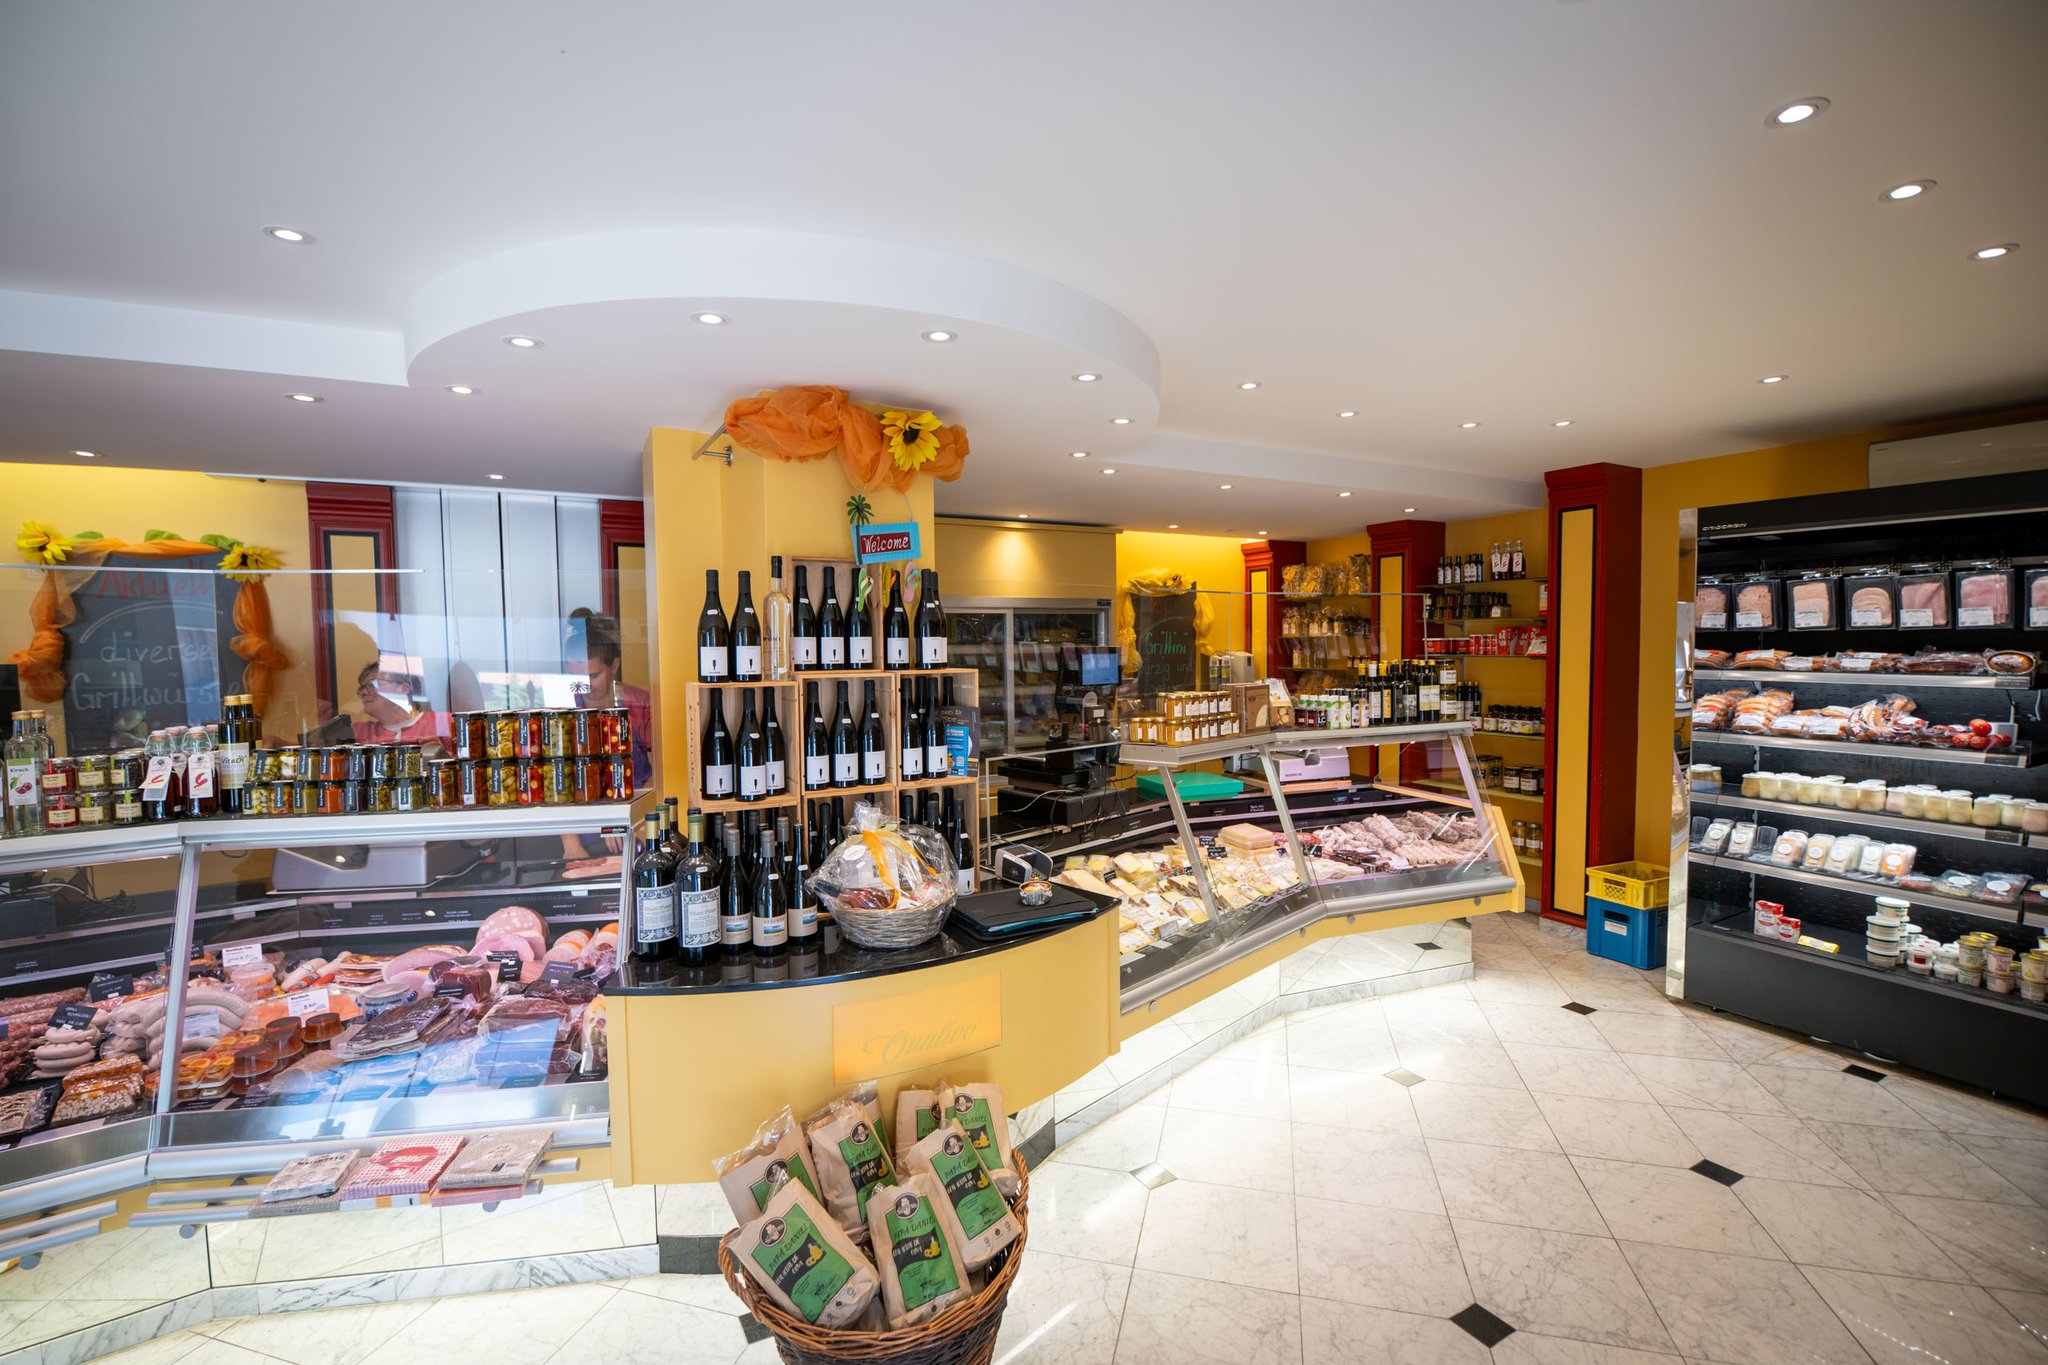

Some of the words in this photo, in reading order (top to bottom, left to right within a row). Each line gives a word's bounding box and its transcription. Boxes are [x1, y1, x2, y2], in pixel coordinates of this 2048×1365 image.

[863, 535, 909, 554] Welcome
[98, 559, 210, 599] Aktuell
[100, 630, 215, 664] diverse
[1145, 630, 1187, 656] Grillini
[1142, 655, 1171, 682] ürzig
